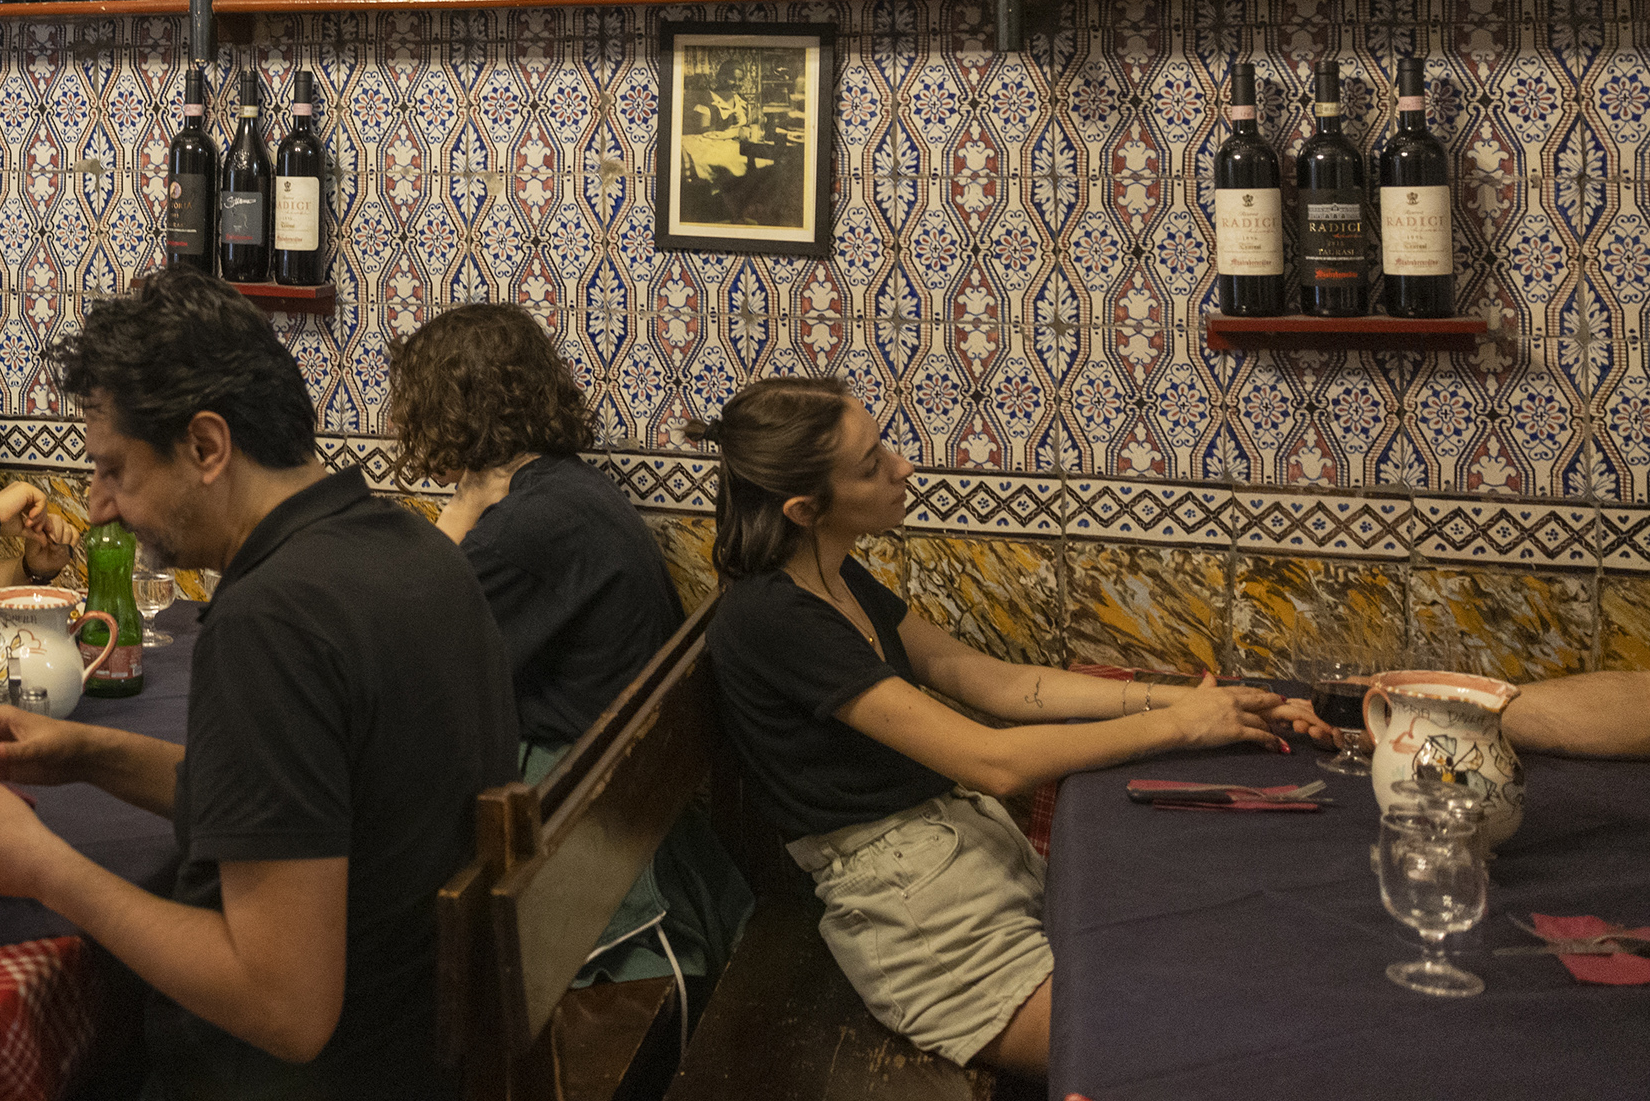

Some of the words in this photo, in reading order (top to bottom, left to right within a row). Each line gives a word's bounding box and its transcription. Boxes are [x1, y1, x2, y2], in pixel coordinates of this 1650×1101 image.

[276, 201, 311, 211] ADICI
[1222, 217, 1277, 228] RADICI
[1386, 215, 1444, 227] RADICI
[1309, 222, 1362, 234] RADICI
